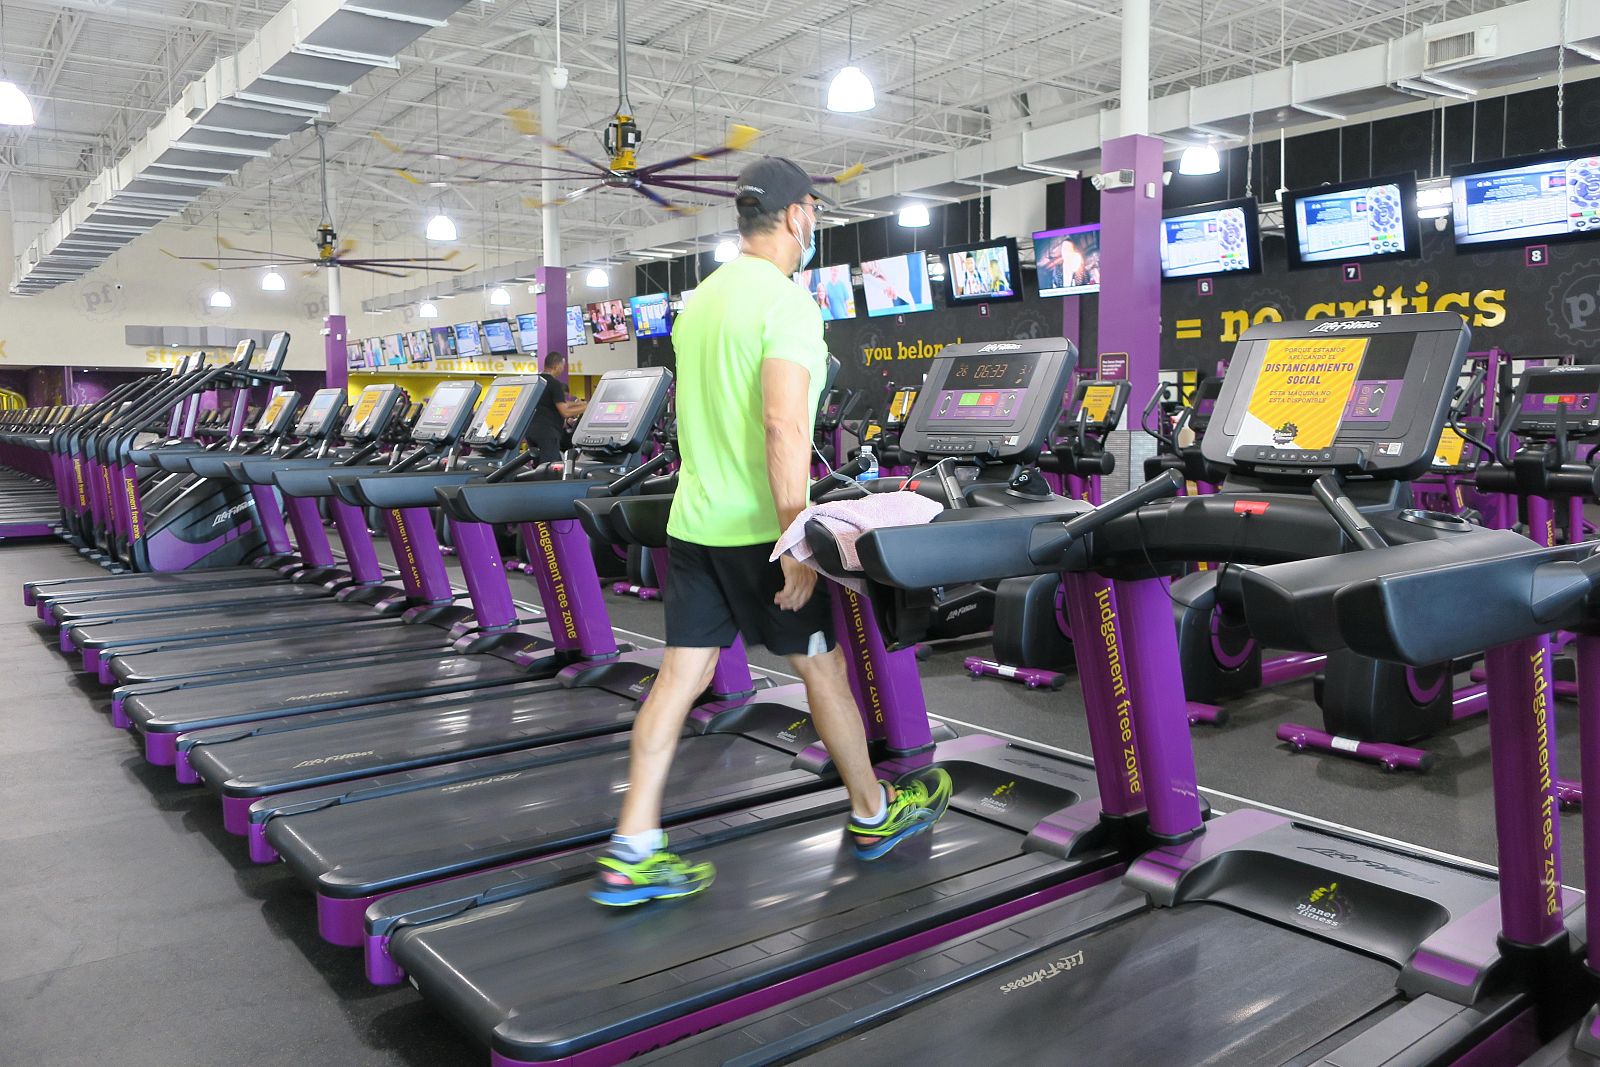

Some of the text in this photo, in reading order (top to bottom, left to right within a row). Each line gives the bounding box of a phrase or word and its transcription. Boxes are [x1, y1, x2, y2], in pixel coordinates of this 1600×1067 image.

[1531, 250, 1542, 262] 8
[1347, 268, 1356, 278] 7
[1201, 282, 1209, 292] 6
[1566, 283, 1600, 329] p
[864, 346, 893, 366] you
[435, 357, 505, 372] minute
[512, 359, 584, 373] wout
[1264, 363, 1354, 373] DISTANCIAMIENTO
[1286, 375, 1321, 385] SOCIAL
[554, 581, 568, 610] free
[562, 609, 577, 640] zone
[1094, 586, 1141, 795] judgement free zone
[1530, 647, 1558, 916] judgement free zone
[1296, 903, 1337, 920] planet
[1297, 909, 1339, 928] fitness
